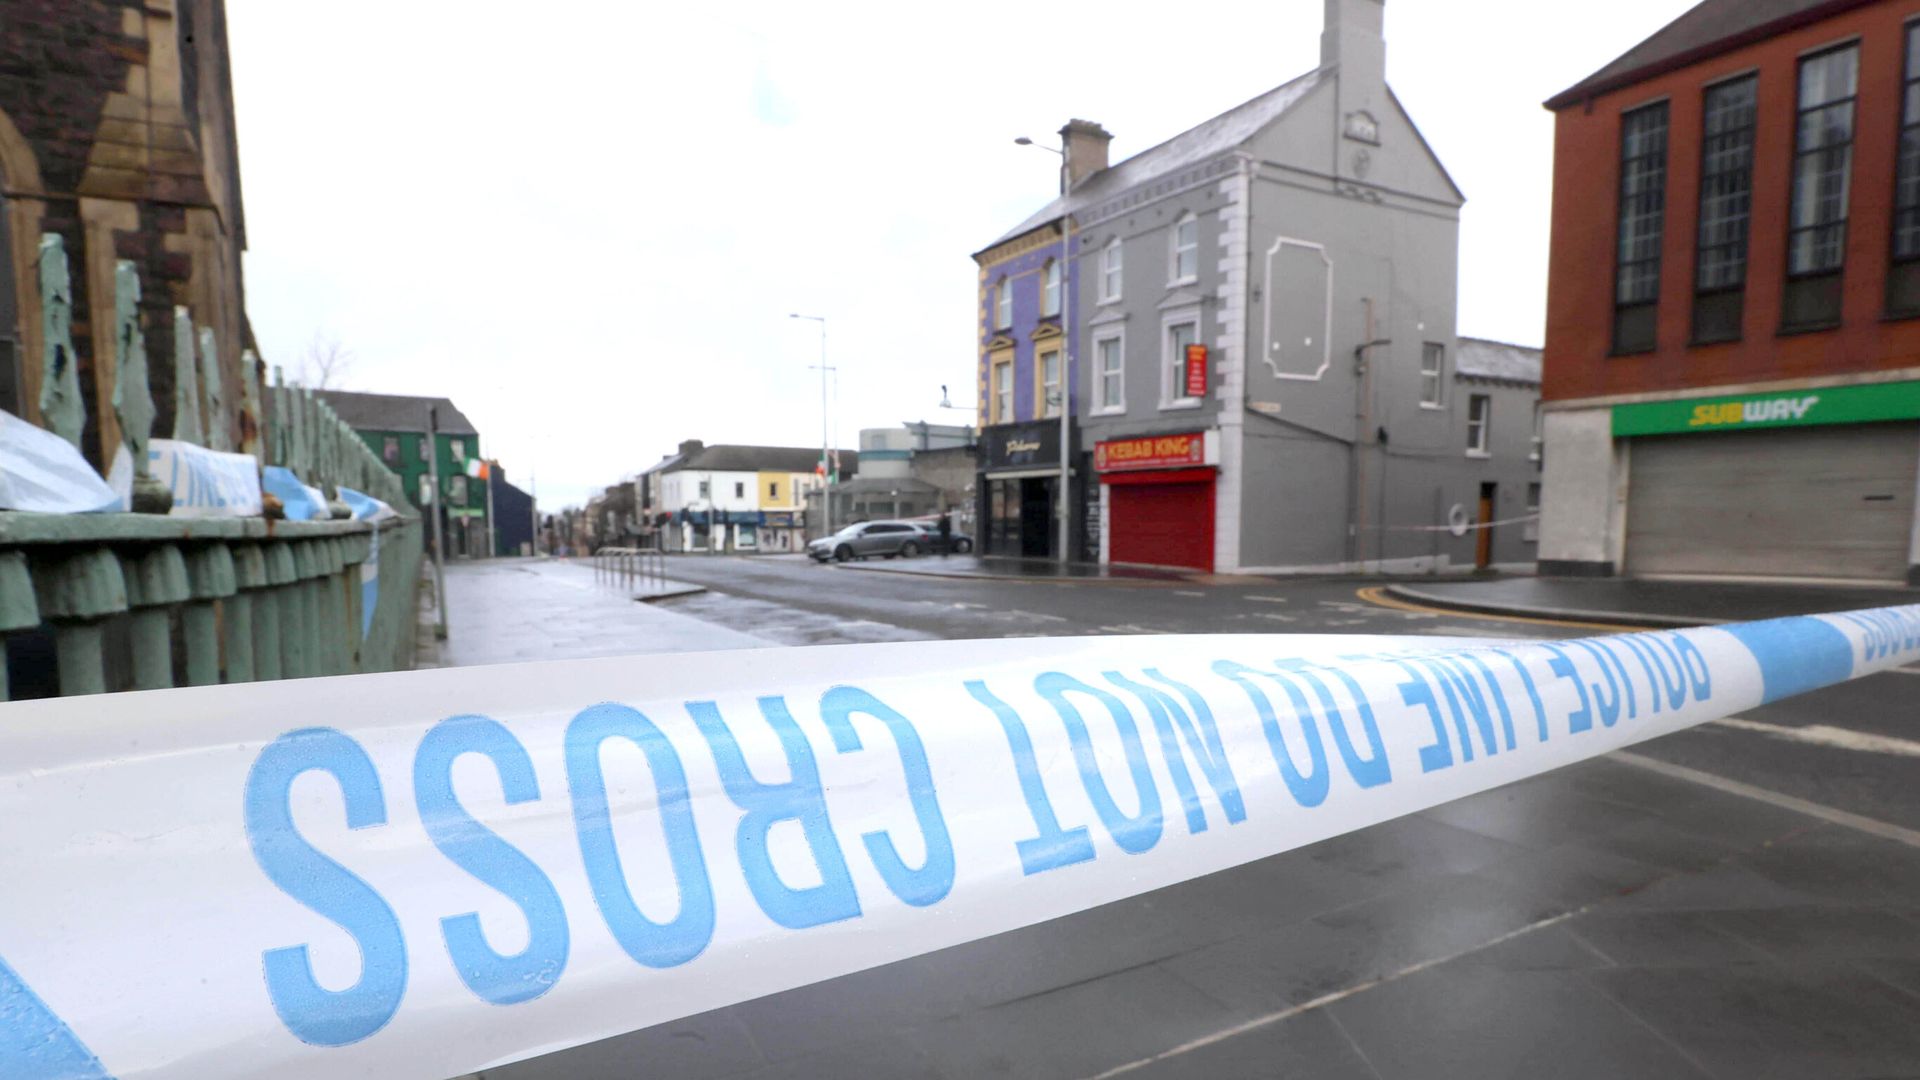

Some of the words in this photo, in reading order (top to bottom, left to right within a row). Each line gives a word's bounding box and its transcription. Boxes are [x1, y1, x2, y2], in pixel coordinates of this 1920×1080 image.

[1108, 440, 1154, 460] KEBAB
[1155, 436, 1190, 456] KING
[1690, 395, 1820, 426] SUBWAY
[1210, 653, 1393, 808] DO
[1376, 648, 1549, 774] LINE
[1538, 630, 1712, 736] POLICE
[963, 666, 1248, 876] NOT
[243, 684, 956, 1047] CROSS
